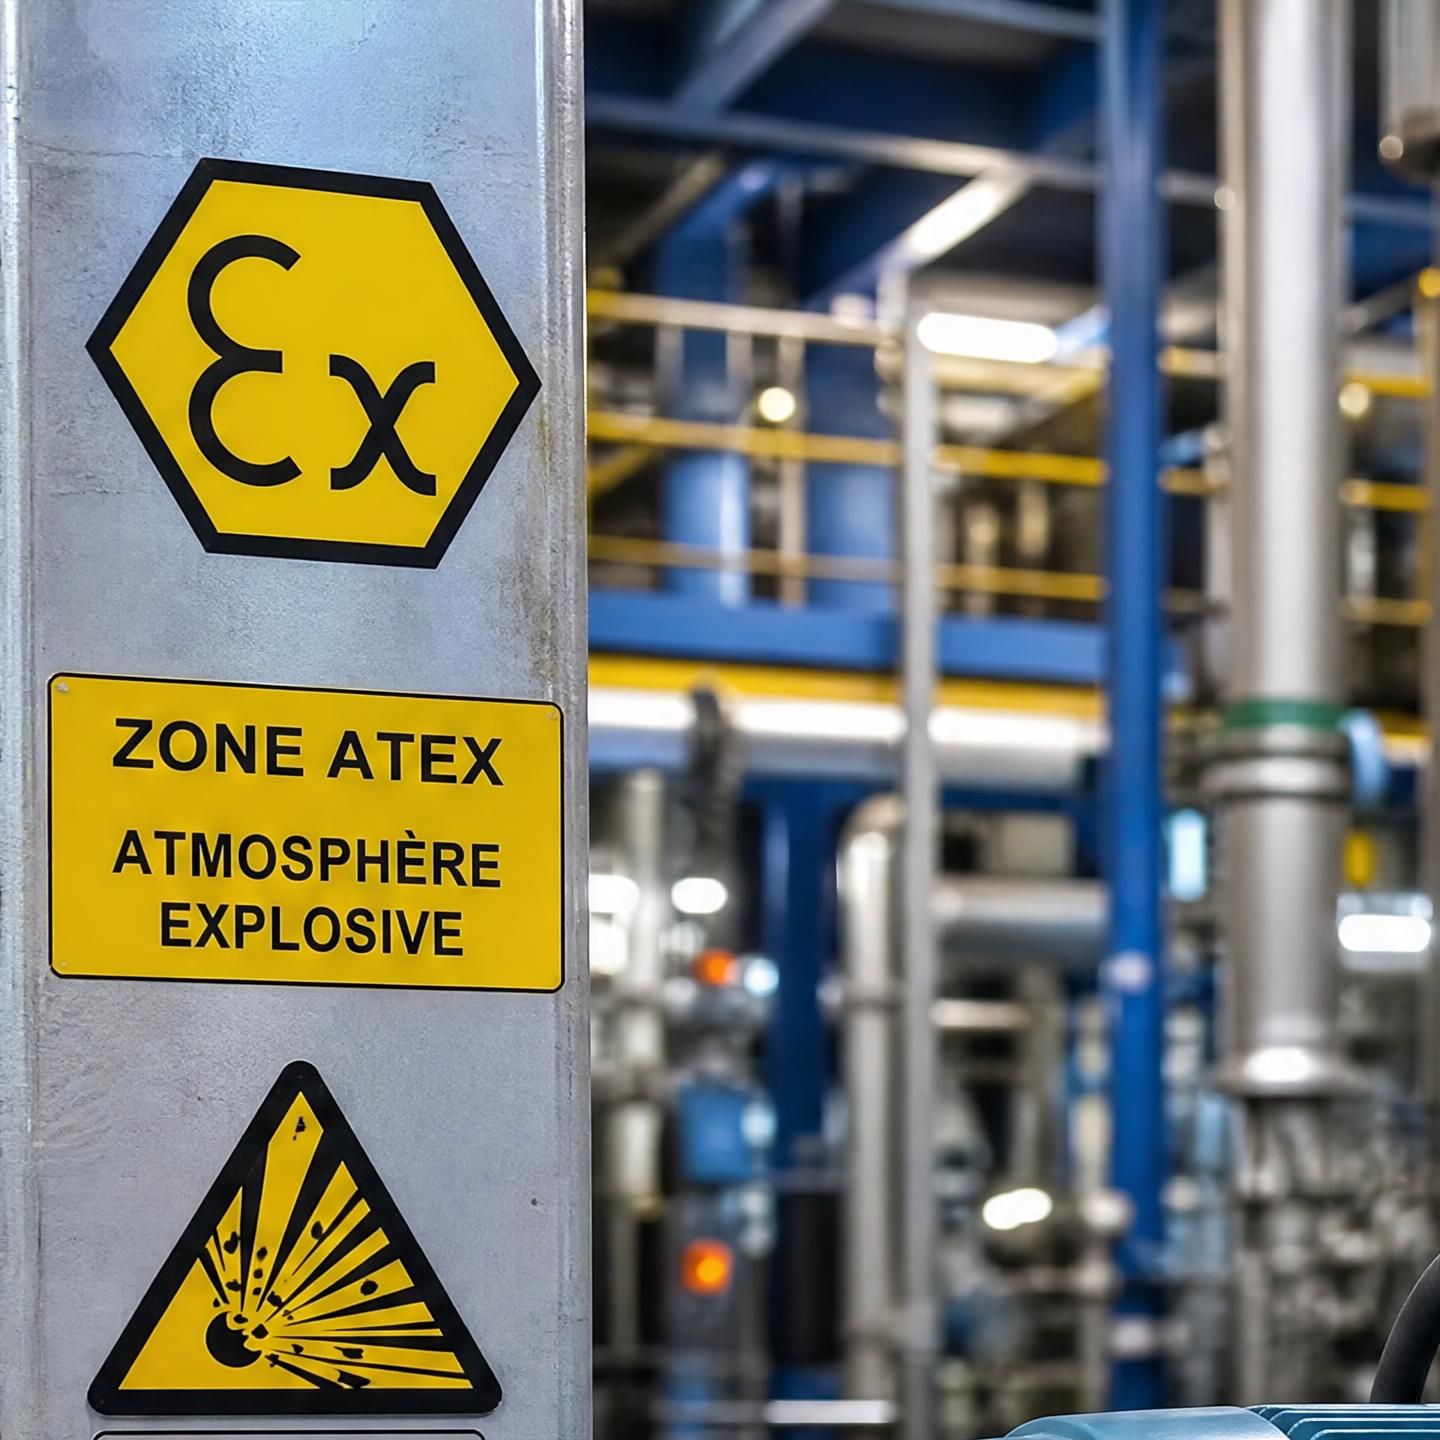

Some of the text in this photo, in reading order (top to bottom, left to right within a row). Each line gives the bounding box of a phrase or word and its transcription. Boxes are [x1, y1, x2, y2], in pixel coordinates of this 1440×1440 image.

[187, 234, 437, 497] Ex
[112, 717, 504, 786] ZONE ATEX
[112, 829, 501, 888] ATMOSPHÈRE
[161, 902, 464, 956] EXPLOSIVE
